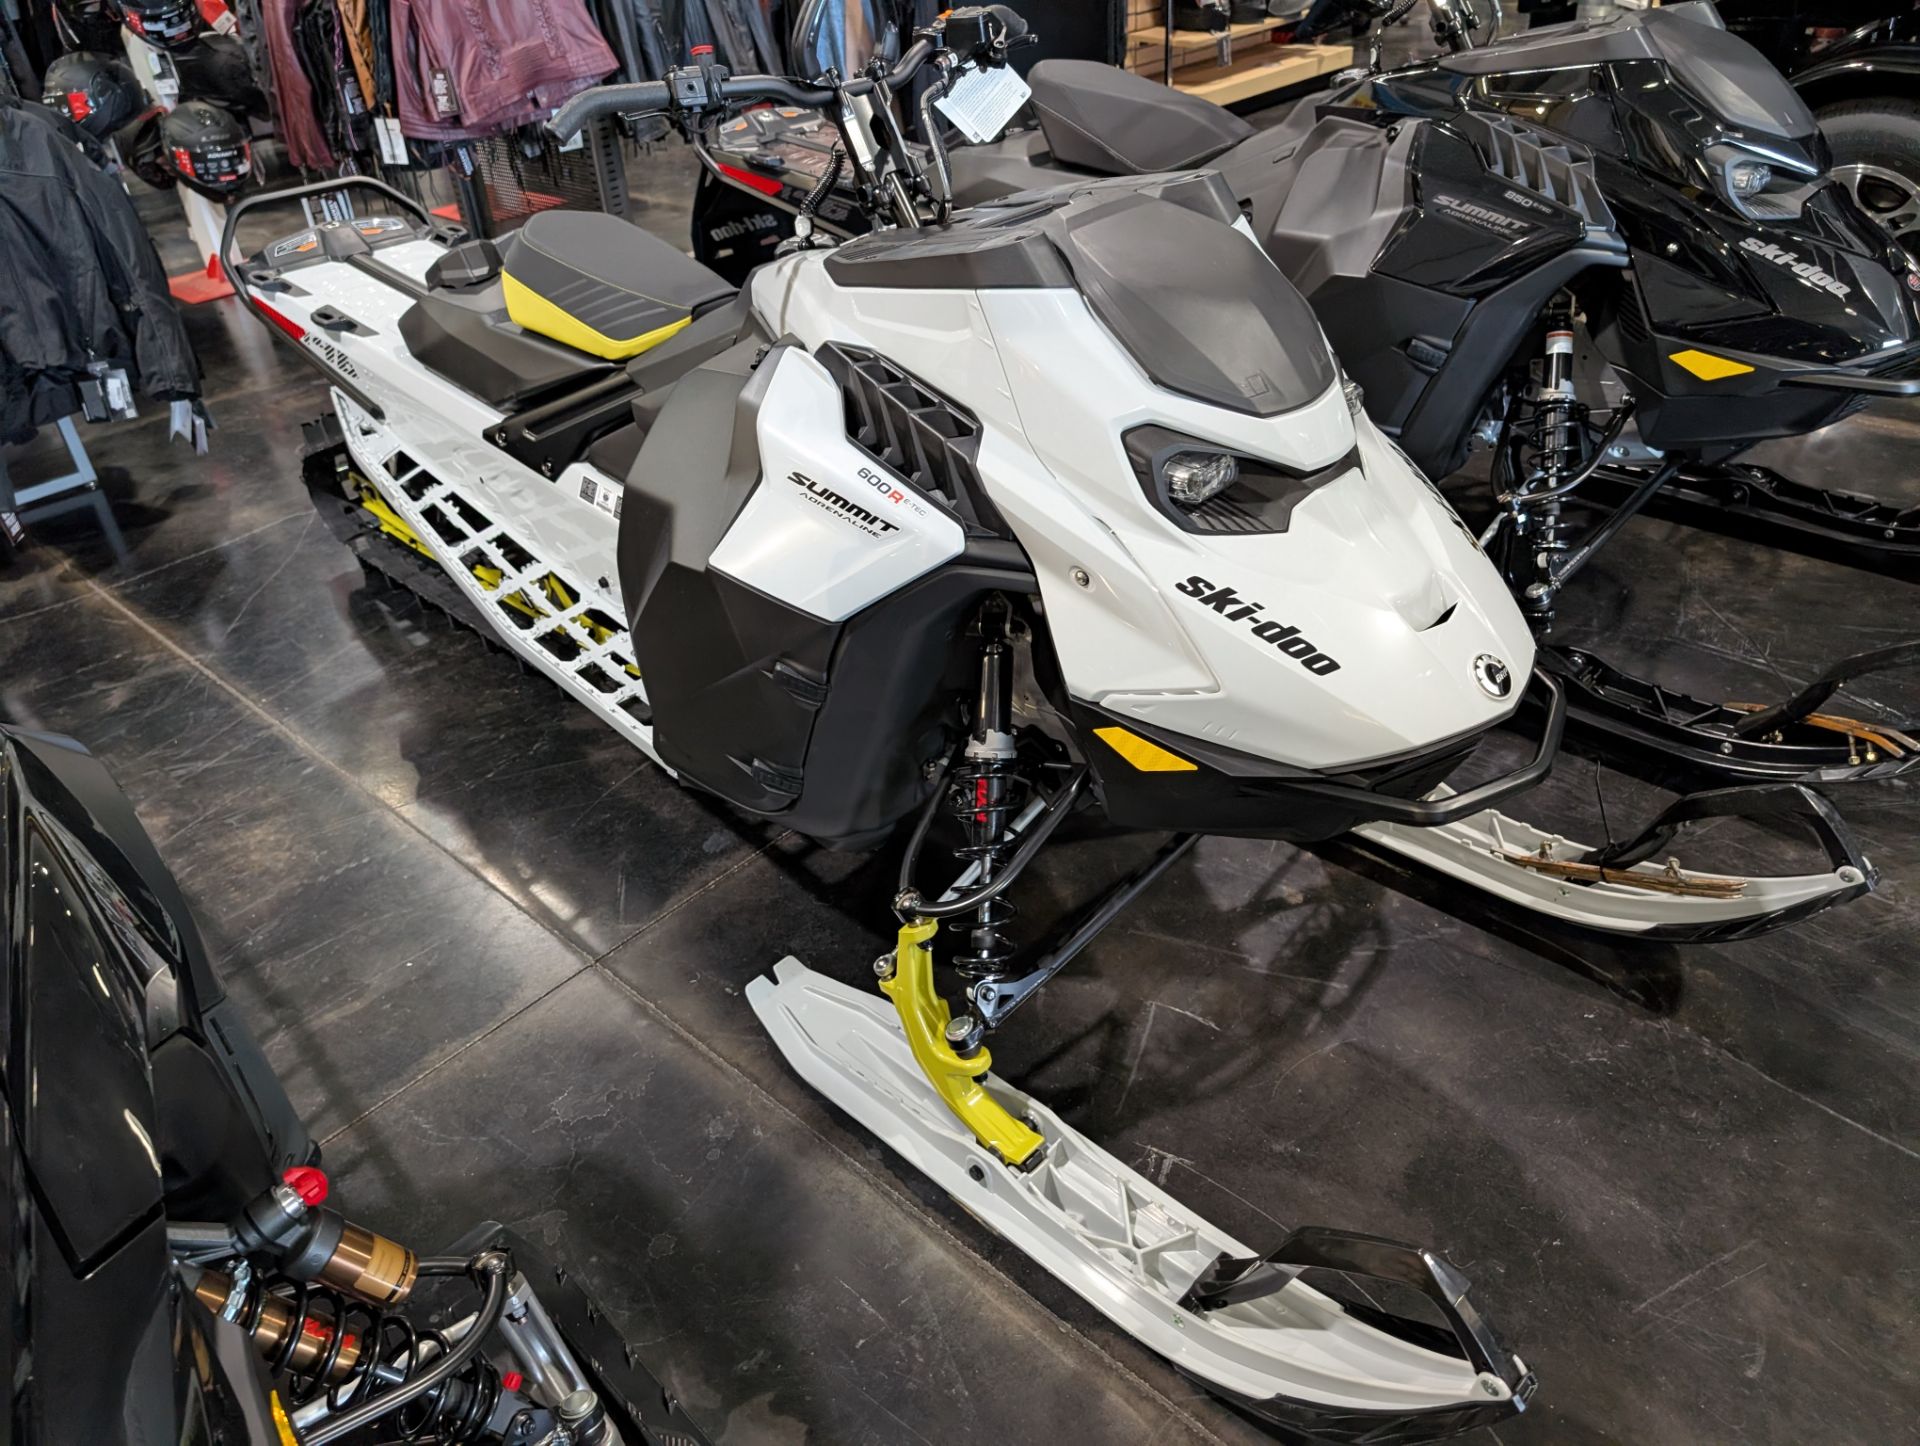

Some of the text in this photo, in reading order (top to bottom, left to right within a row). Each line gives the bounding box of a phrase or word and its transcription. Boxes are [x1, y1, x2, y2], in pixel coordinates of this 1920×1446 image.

[1432, 194, 1529, 230] SUMMIT
[1443, 207, 1513, 235] ADRENALINE
[1503, 189, 1534, 208] 850
[1738, 236, 1852, 297] ski-doo
[786, 471, 900, 533] SUMMIT
[799, 492, 883, 539] ADRENALINE
[857, 467, 928, 517] 600R E-TEC
[1175, 575, 1341, 676] ski-doo
